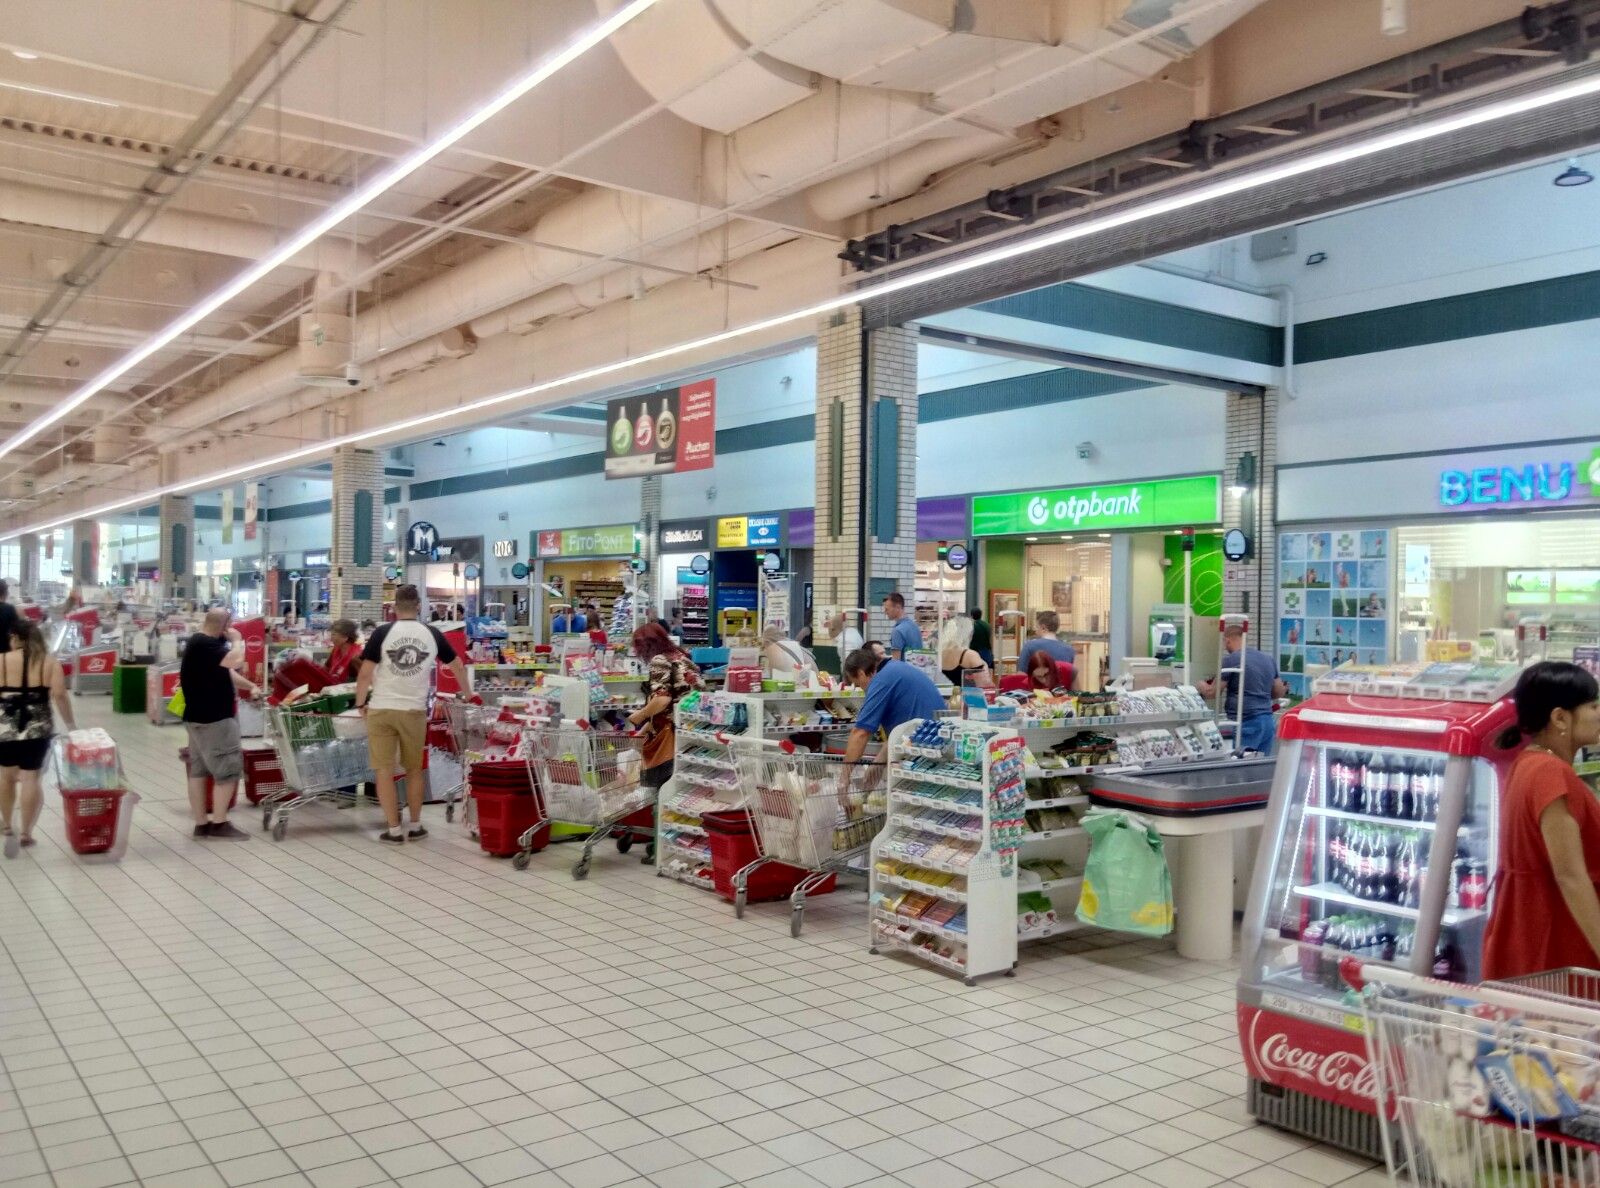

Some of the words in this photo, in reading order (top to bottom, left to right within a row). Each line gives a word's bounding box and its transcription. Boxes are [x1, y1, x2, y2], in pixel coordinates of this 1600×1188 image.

[1053, 487, 1141, 525] otpbank
[1438, 462, 1574, 507] BENU
[1260, 1033, 1378, 1099] Coca-Cola
